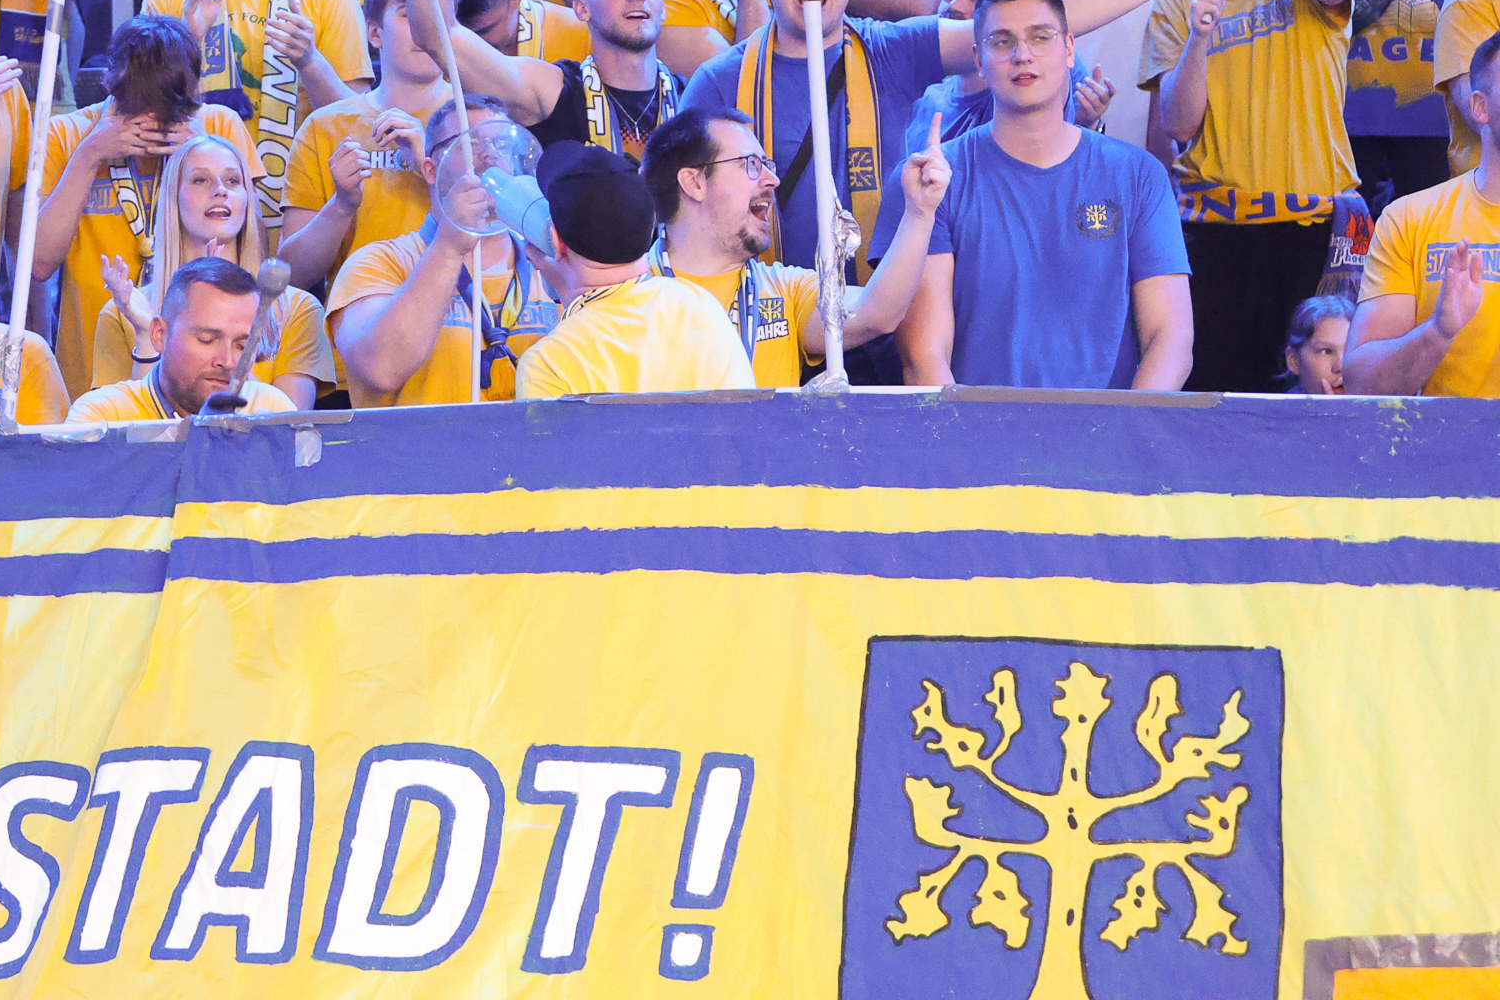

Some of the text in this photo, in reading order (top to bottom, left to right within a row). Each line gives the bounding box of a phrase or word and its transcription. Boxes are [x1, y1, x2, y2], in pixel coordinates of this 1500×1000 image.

[242, 12, 267, 26] FOR
[1347, 36, 1436, 62] AGE
[756, 320, 790, 342] AHRE
